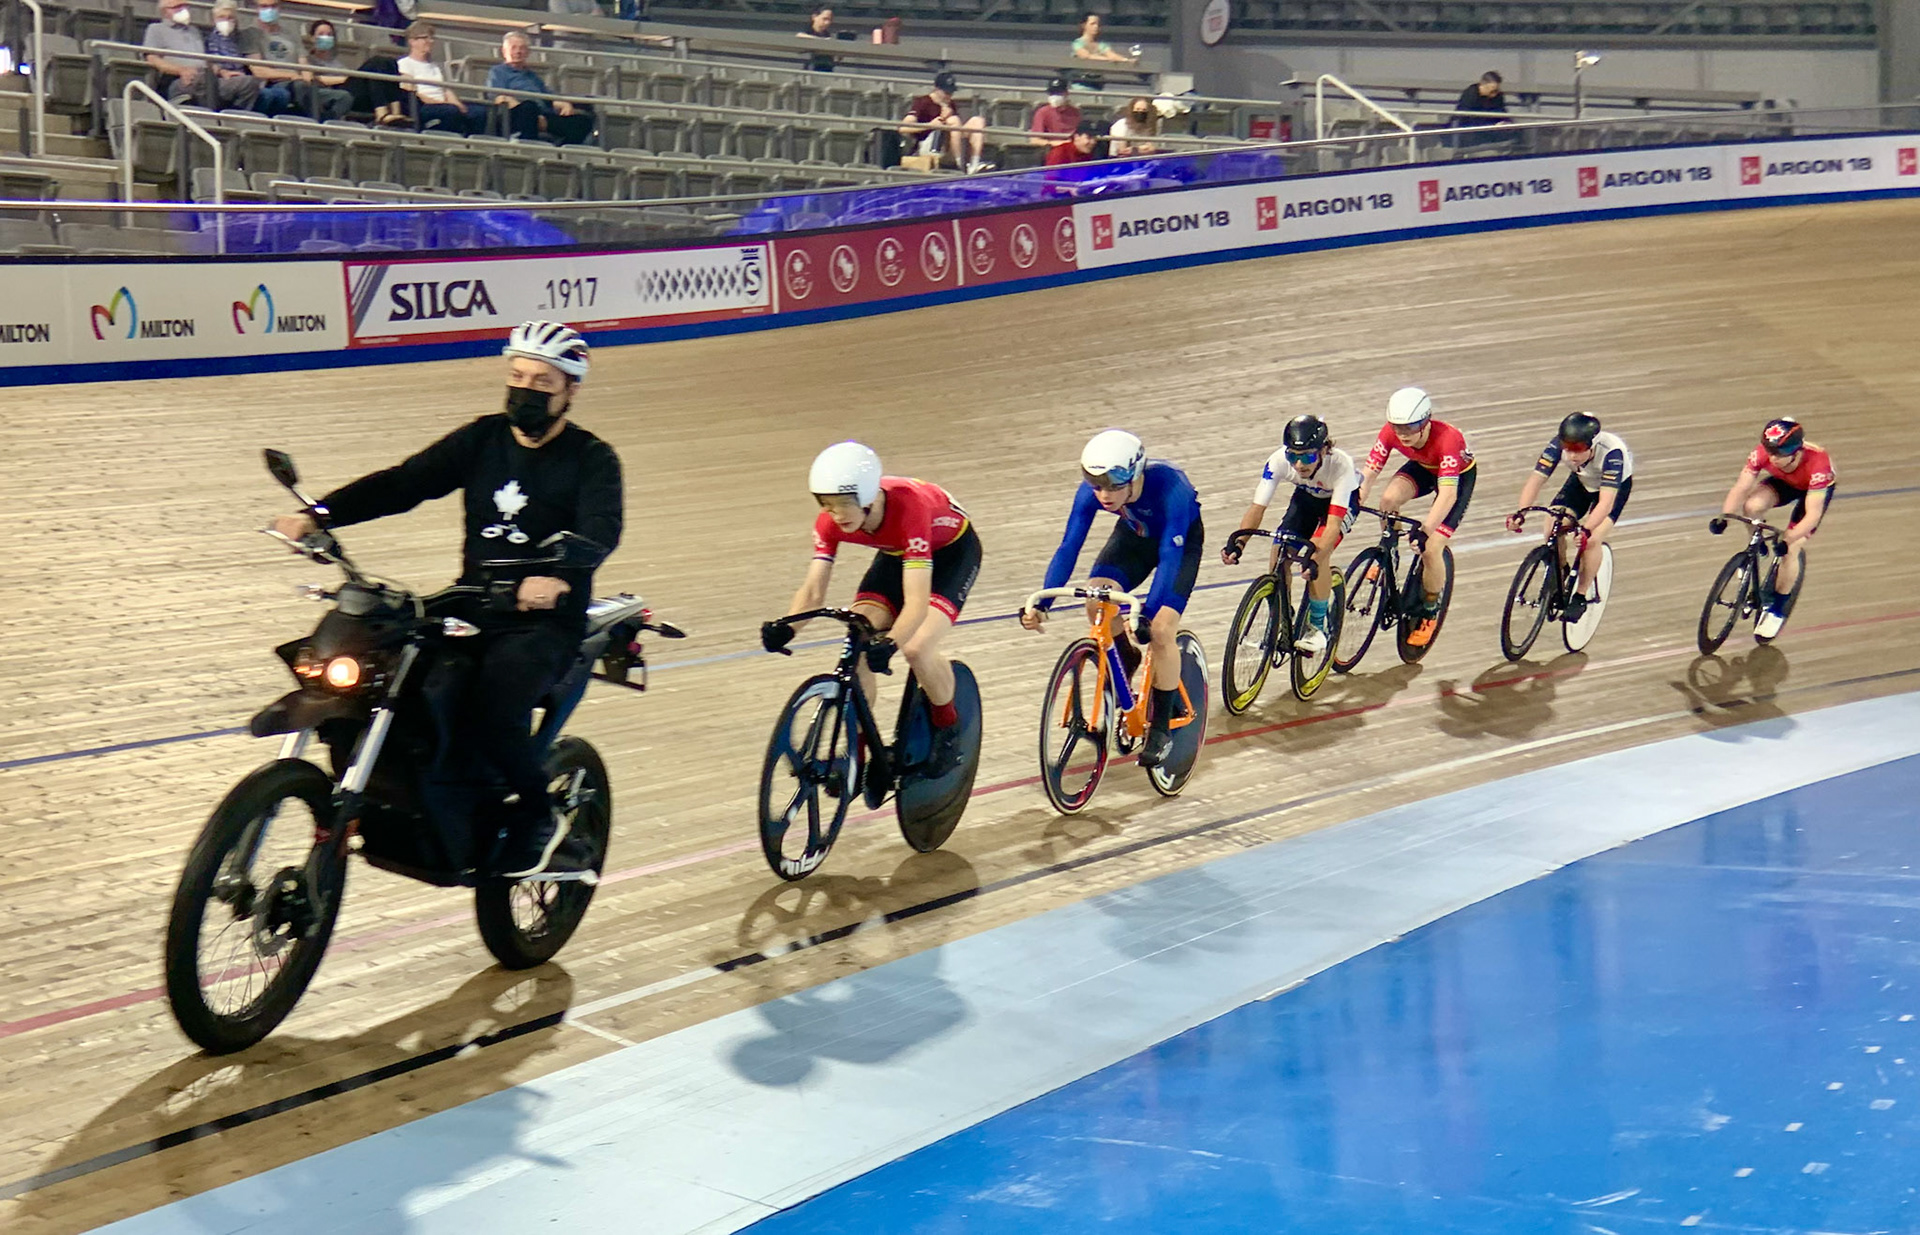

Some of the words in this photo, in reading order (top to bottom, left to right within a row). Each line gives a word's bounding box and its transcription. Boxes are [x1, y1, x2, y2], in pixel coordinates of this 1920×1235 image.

[1603, 169, 1682, 188] ARGON
[1686, 166, 1712, 181] 18
[1765, 161, 1843, 176] ARGON
[1847, 157, 1872, 171] 18
[1444, 181, 1523, 202] ARGON
[1528, 179, 1553, 194] 18
[1282, 196, 1363, 219] ARGON
[1366, 193, 1393, 210] 18
[1118, 213, 1199, 238] ARGON
[1203, 210, 1229, 228] 18
[388, 280, 498, 322] SILCA
[545, 277, 598, 310] 1917
[140, 319, 195, 338] MILTON
[277, 314, 326, 332] MILTON
